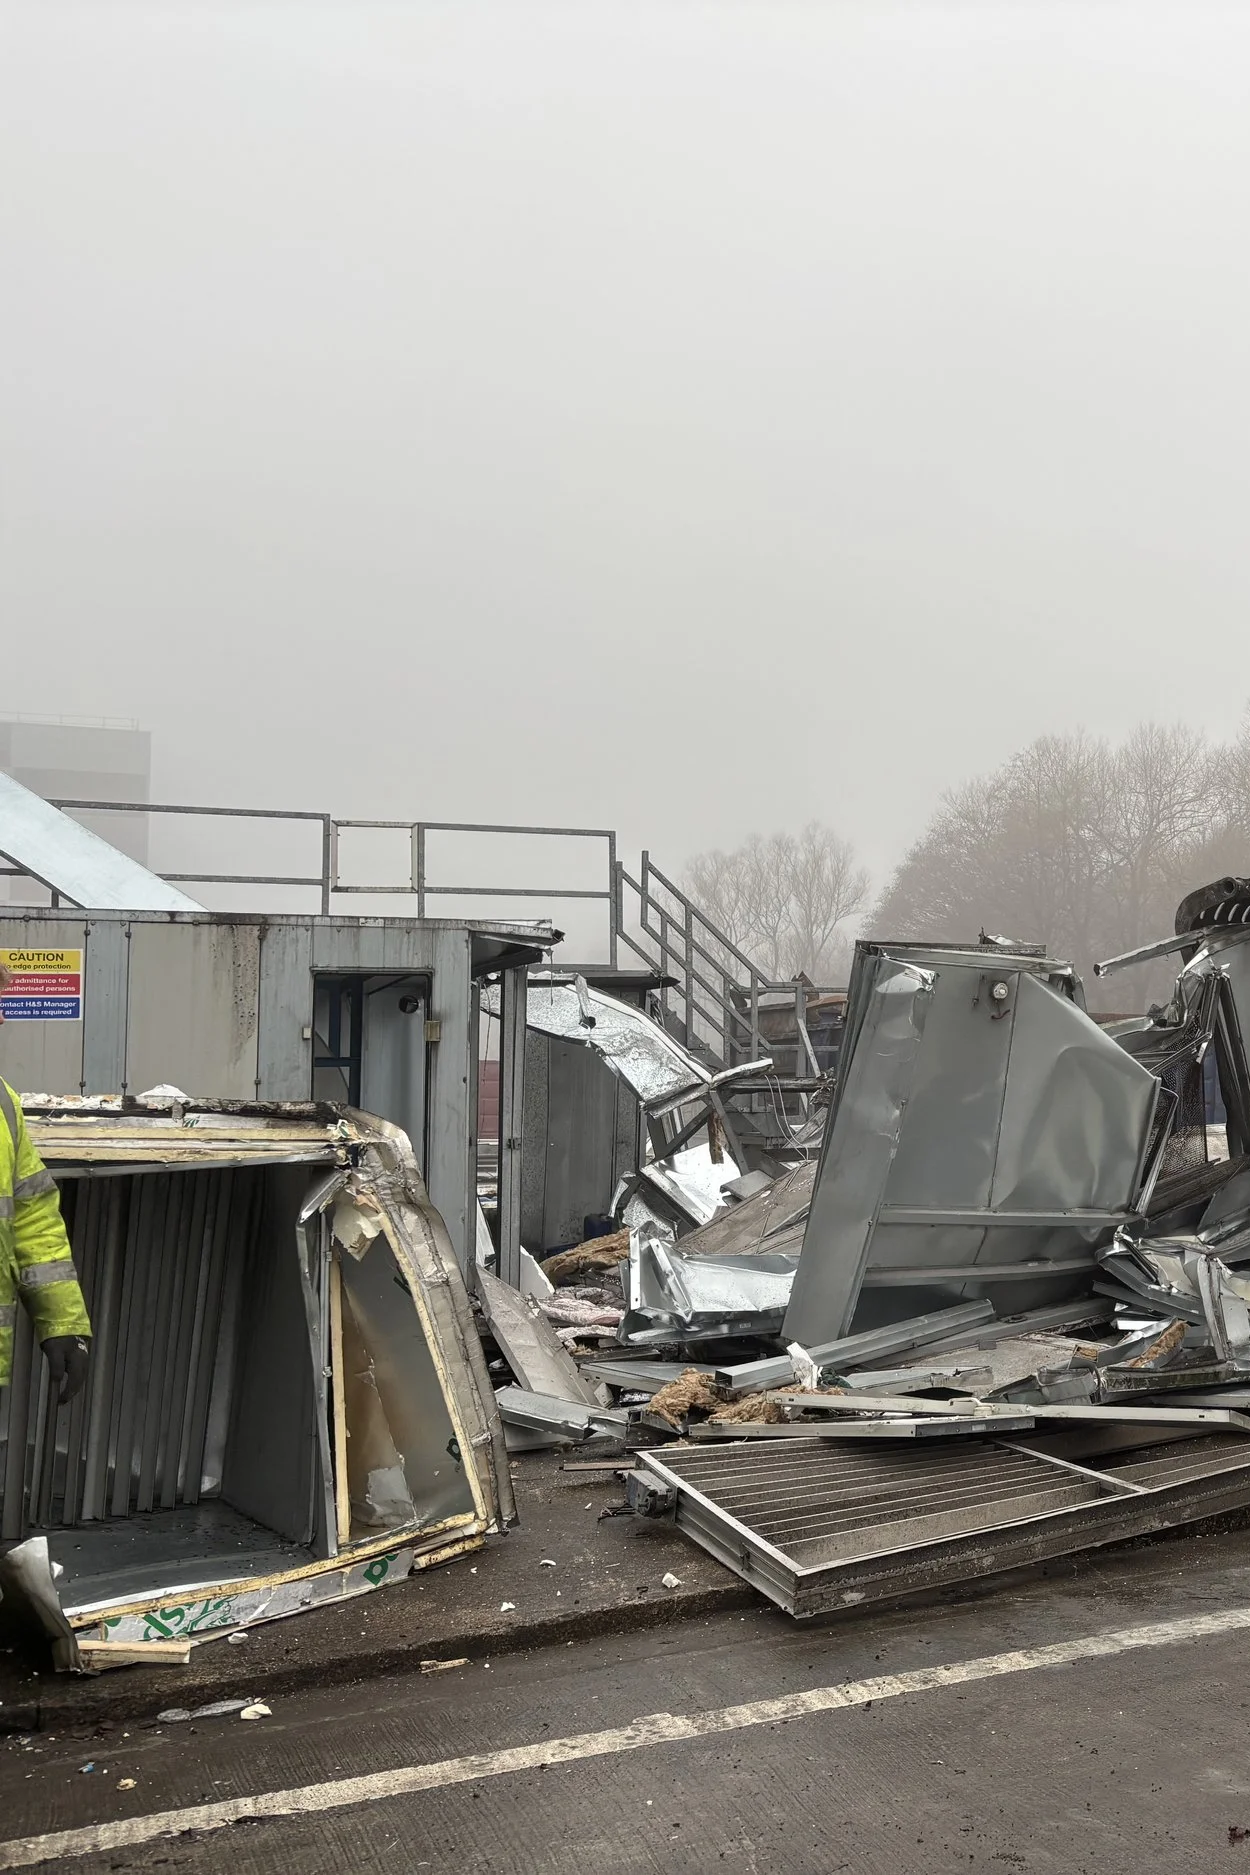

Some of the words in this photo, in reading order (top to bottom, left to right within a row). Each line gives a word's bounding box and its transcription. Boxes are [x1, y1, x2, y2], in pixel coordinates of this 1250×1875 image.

[9, 952, 64, 961] CAUTION
[13, 963, 32, 971] edge
[33, 963, 72, 971] protection
[43, 1001, 77, 1009] Manager
[32, 1008, 40, 1016] is
